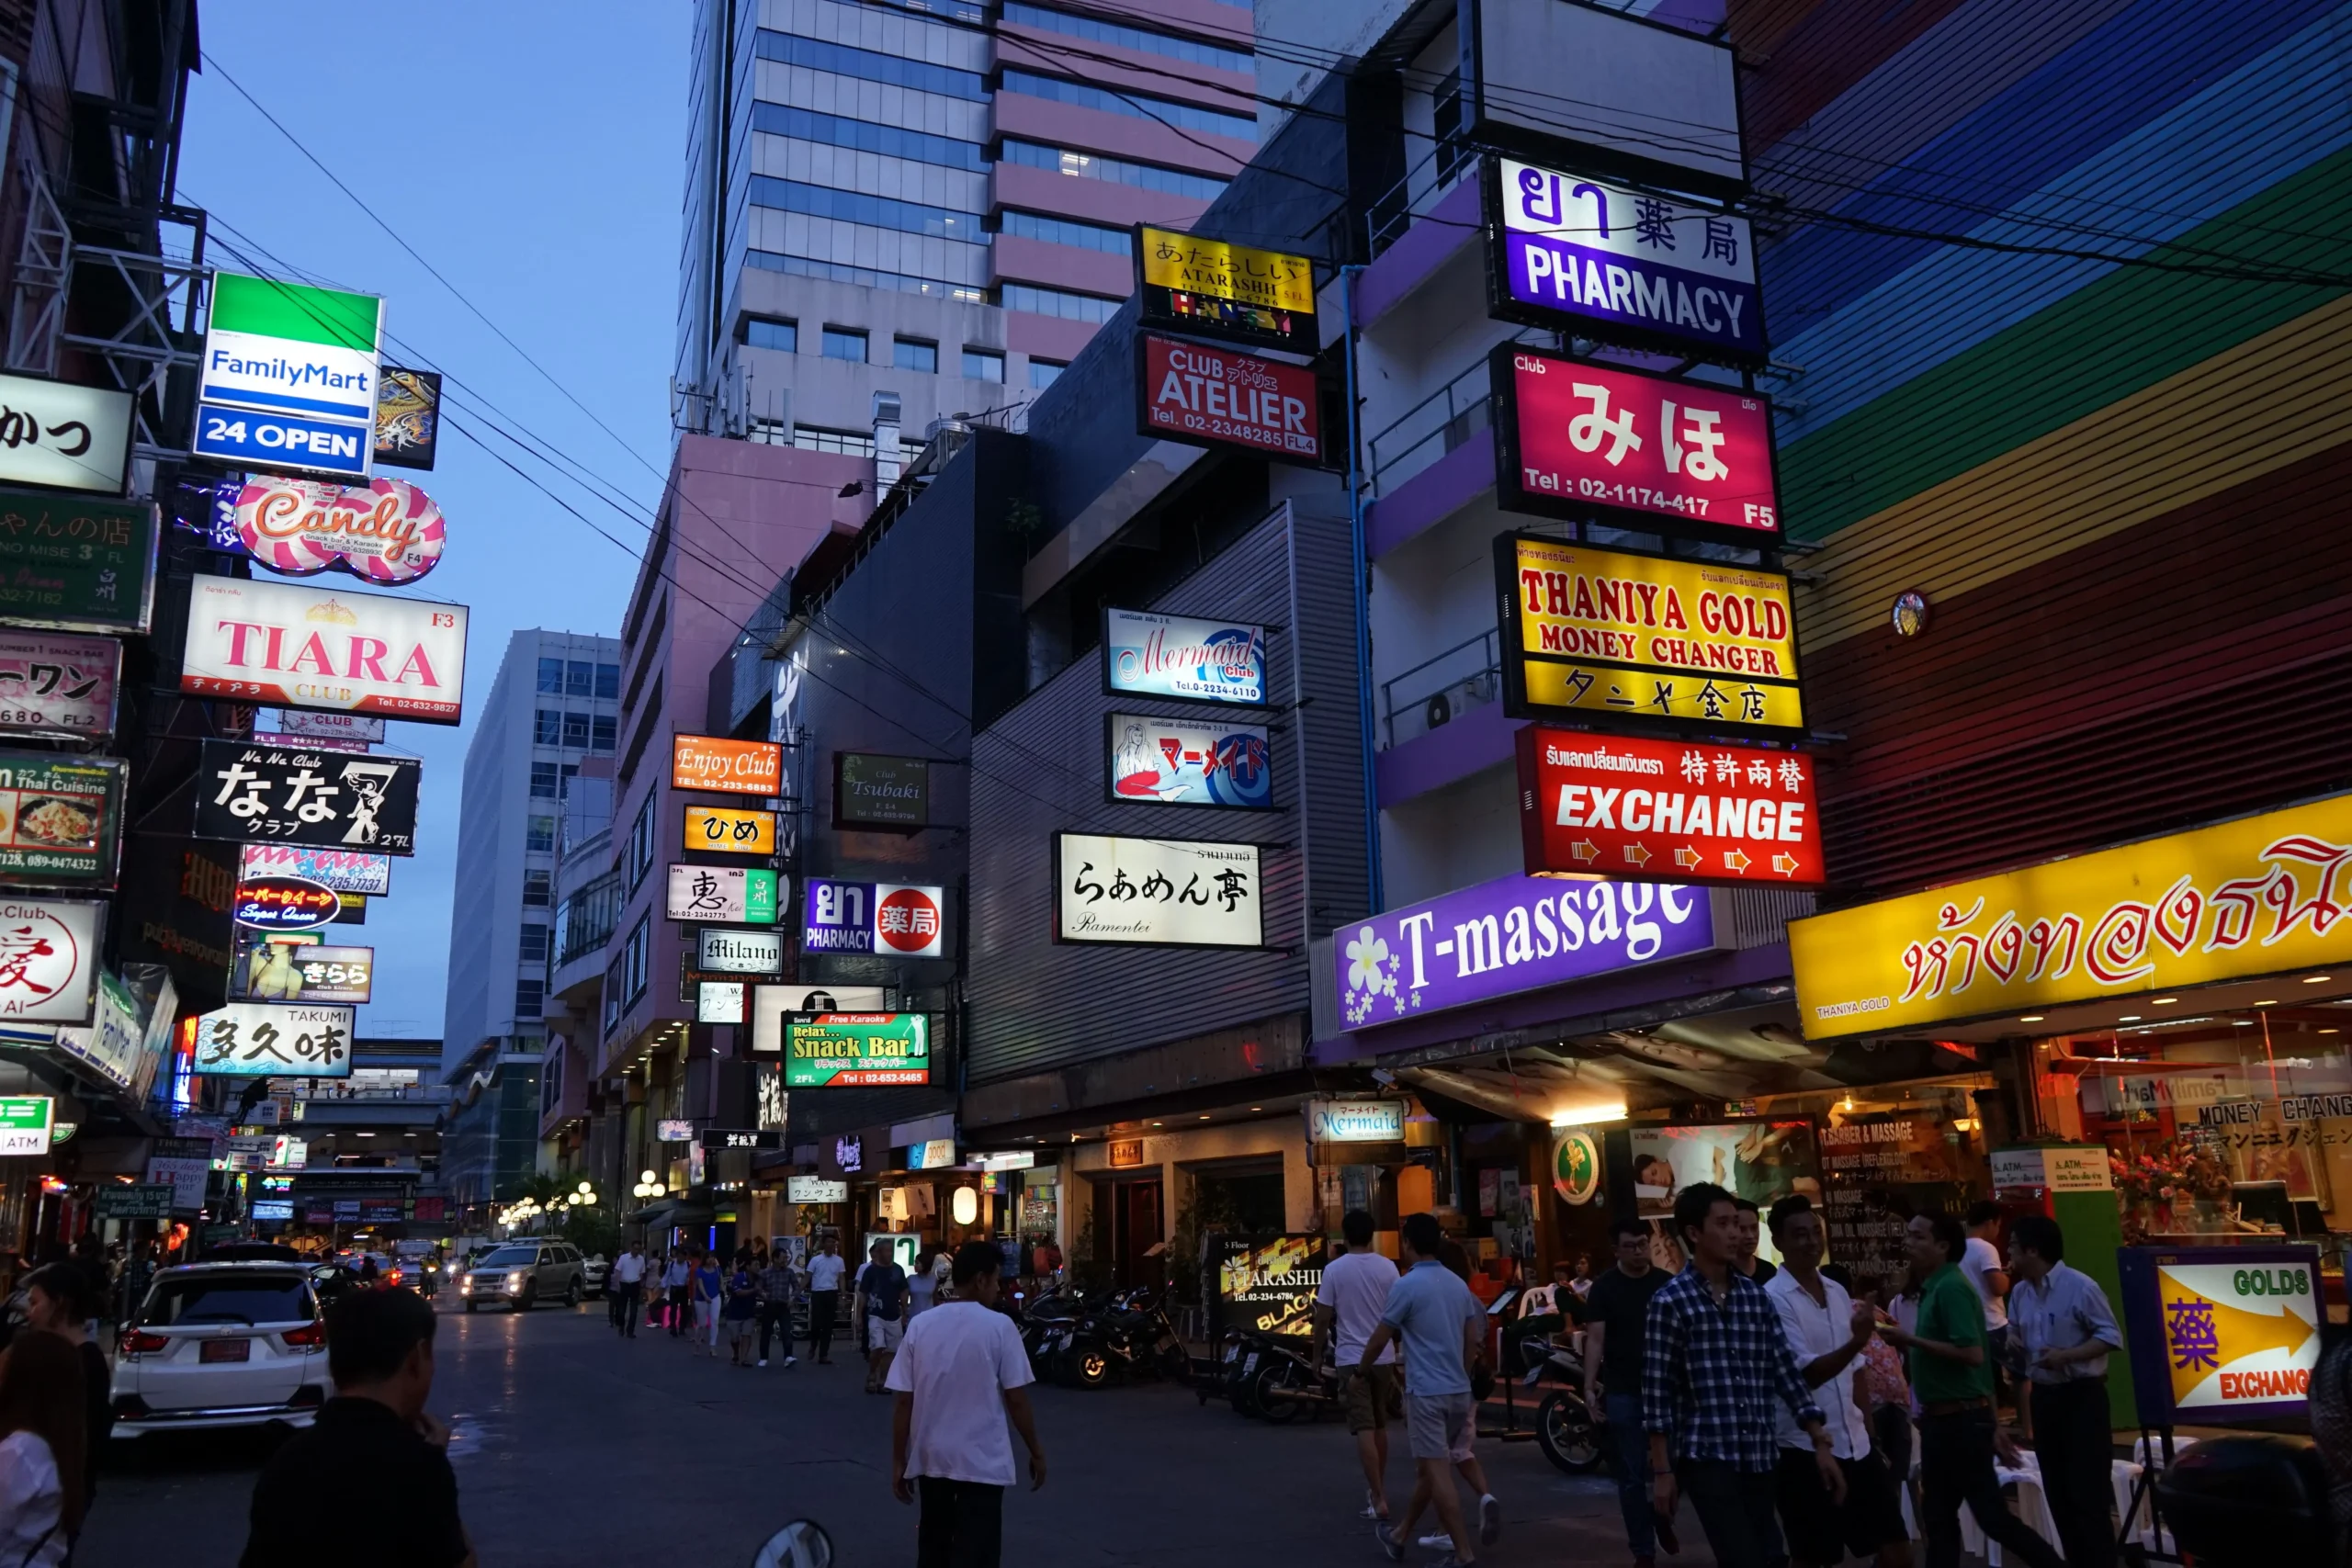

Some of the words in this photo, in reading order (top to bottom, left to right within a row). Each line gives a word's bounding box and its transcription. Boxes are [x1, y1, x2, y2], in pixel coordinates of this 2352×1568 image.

[1518, 167, 1610, 240] ยา
[1634, 198, 1737, 266] 薬局
[1156, 242, 1297, 280] あたらしい
[1181, 267, 1277, 297] ATARASHII
[1182, 282, 1210, 294] TEL.
[1525, 243, 1744, 339] PHARMACY
[211, 350, 368, 392] FamilyMart
[1169, 349, 1224, 378] CLUB
[1237, 357, 1267, 373] クラブ
[1514, 356, 1546, 375] Club
[1227, 367, 1278, 391] アトリエ
[1158, 370, 1306, 434] ATELIER
[206, 418, 247, 443] 24
[254, 424, 357, 457] OPEN
[1151, 406, 1179, 425] Tel.
[1184, 413, 1283, 446] 02-2348285
[1287, 436, 1315, 452] FL.4
[1568, 382, 1729, 481] みほ
[1525, 468, 1559, 491] Tel
[1579, 478, 1709, 515] 02-1174-417
[1744, 503, 1774, 528] F5
[255, 492, 421, 561] Candy
[29, 544, 71, 558] MISE
[305, 534, 328, 543] Snack
[354, 539, 384, 548] Karaoke
[407, 553, 422, 563] F4
[1701, 570, 1786, 592] รับแลกเปลี่ยนเงินตรา
[1521, 568, 1688, 631] THANIYA
[1699, 589, 1788, 641] GOLD
[431, 612, 454, 627] F3
[49, 648, 81, 657] SNACK
[217, 620, 443, 688] TIARA
[1117, 627, 1257, 682] Mermaid
[1539, 623, 1638, 660] MONEY
[1650, 637, 1781, 676] CHANGER
[1225, 666, 1255, 678] Club
[192, 677, 261, 694] ティアラ
[295, 682, 352, 702] CLUB
[378, 697, 395, 707] Tel.
[398, 699, 457, 713] 02-632-9827
[63, 714, 96, 726] FL.2
[315, 715, 353, 727] CLUB
[241, 750, 262, 763] Na
[266, 752, 288, 765] Na
[292, 754, 322, 768] Club
[677, 748, 731, 778] Enjoy
[735, 752, 775, 776] Club
[1159, 738, 1263, 779] マーメイド
[1546, 744, 1665, 776] รับแลกเปลี่ยนเงินตรา
[876, 769, 896, 779] Club
[17, 777, 48, 790] Thai
[51, 780, 107, 795] Cuisine
[214, 763, 339, 823] なな
[677, 777, 701, 787] TEL.
[704, 778, 774, 793] 02-233-6883
[852, 780, 920, 800] Tsubaki
[1556, 784, 1806, 842] EXCHANGE
[247, 818, 300, 836] クラブ
[703, 817, 759, 842] ひめ
[707, 842, 729, 851] HIME
[28, 855, 96, 870] 089-0474322
[1074, 862, 1248, 913] らあめん亭
[3, 905, 46, 919] Club
[240, 904, 278, 921] Super
[282, 907, 317, 921] Queen
[727, 901, 743, 913] Kei
[817, 885, 864, 925] ยา
[881, 906, 935, 934] 薬局
[1071, 911, 1152, 933] Ramentei
[1899, 834, 2352, 1003] ห้างทองธนิ
[807, 928, 872, 950] PHARMACY
[1399, 880, 1694, 990] T-massage
[707, 939, 778, 960] Milano
[303, 963, 368, 985] きらら
[6, 999, 24, 1014] AI
[288, 1011, 347, 1023] TAKUMI
[1815, 1001, 1860, 1020] THANIYA
[1860, 996, 1891, 1014] GOLD
[829, 1015, 849, 1024] Free
[851, 1015, 886, 1024] Karaoke
[201, 1018, 345, 1066] 多久味
[793, 1026, 841, 1038] Relax...
[793, 1036, 860, 1058] Snack
[867, 1037, 910, 1057] Bar
[842, 1074, 856, 1083] Tel
[865, 1073, 922, 1083] 02-652-5465
[1314, 1110, 1401, 1135] Mermaid
[2198, 1101, 2262, 1126] MONEY
[7, 1137, 38, 1148] ATM
[1863, 1124, 1871, 1143] &
[1871, 1121, 1914, 1143] MASSAGE
[928, 1145, 946, 1164] good
[1832, 1154, 1860, 1169] MASSAGE
[2064, 1160, 2082, 1169] ATM
[154, 1160, 176, 1171] 365
[180, 1160, 205, 1172] days
[2003, 1162, 2022, 1172] ATM
[155, 1171, 203, 1185] Happy
[146, 1190, 154, 1200] 15
[1834, 1189, 1863, 1203] MASSAGE
[1845, 1223, 1856, 1237] OIL
[1857, 1222, 1888, 1237] MASSAGE
[2233, 1269, 2311, 1296] GOLDS
[2219, 1369, 2313, 1400] EXCHANG
